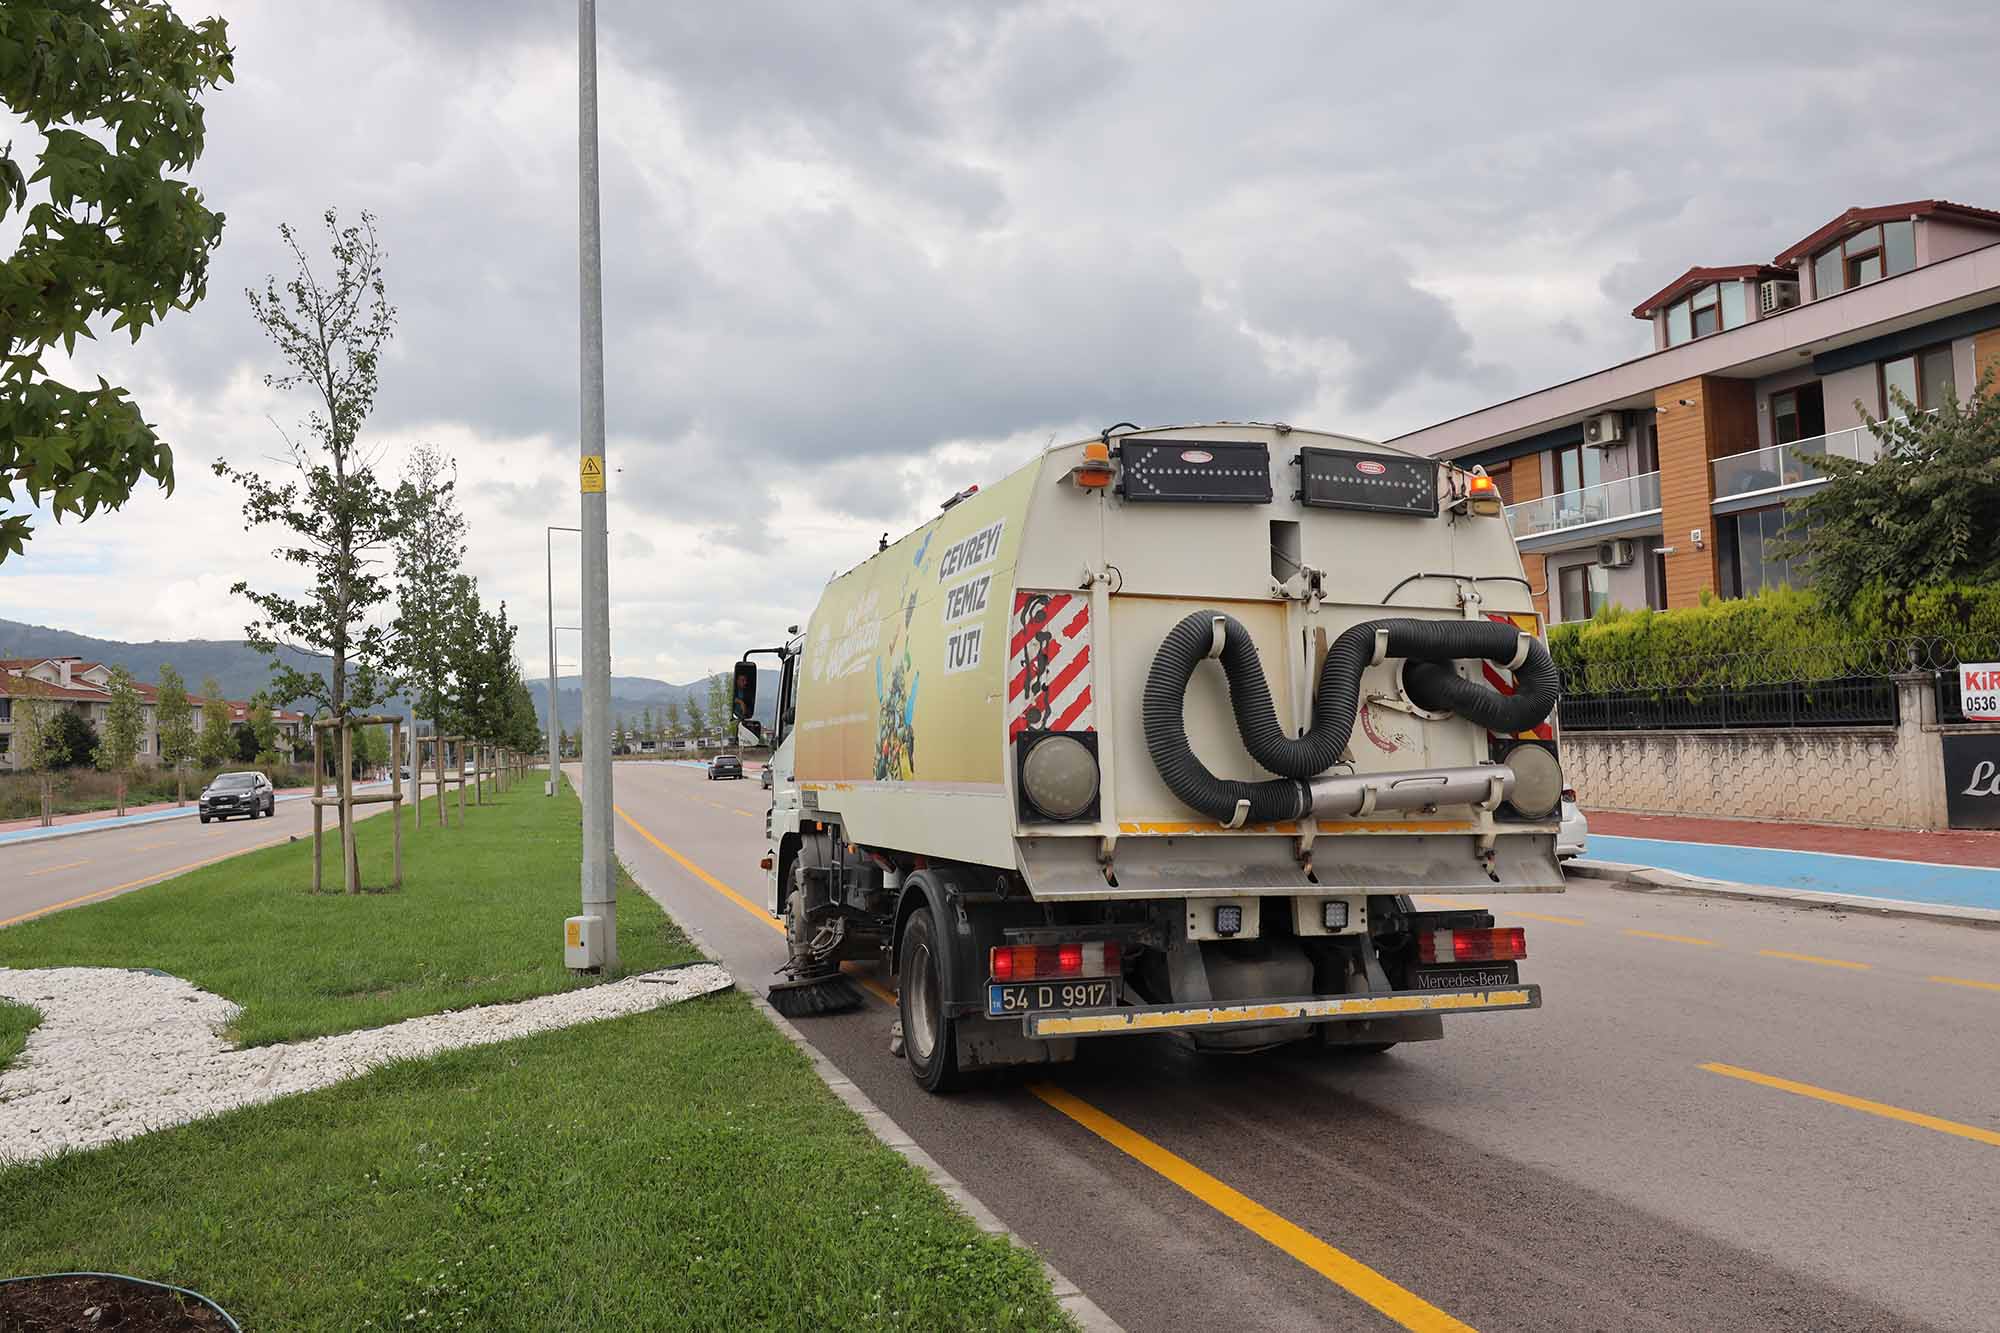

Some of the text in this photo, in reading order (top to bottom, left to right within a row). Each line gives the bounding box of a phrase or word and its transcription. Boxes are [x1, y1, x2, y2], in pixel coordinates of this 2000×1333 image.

[946, 576, 990, 620] TEMİZ
[949, 629, 981, 669] TUT!
[1966, 696, 1996, 711] 0536
[1418, 971, 1509, 989] Mercedes-Benz
[1003, 984, 1106, 1010] 54 D 9917
